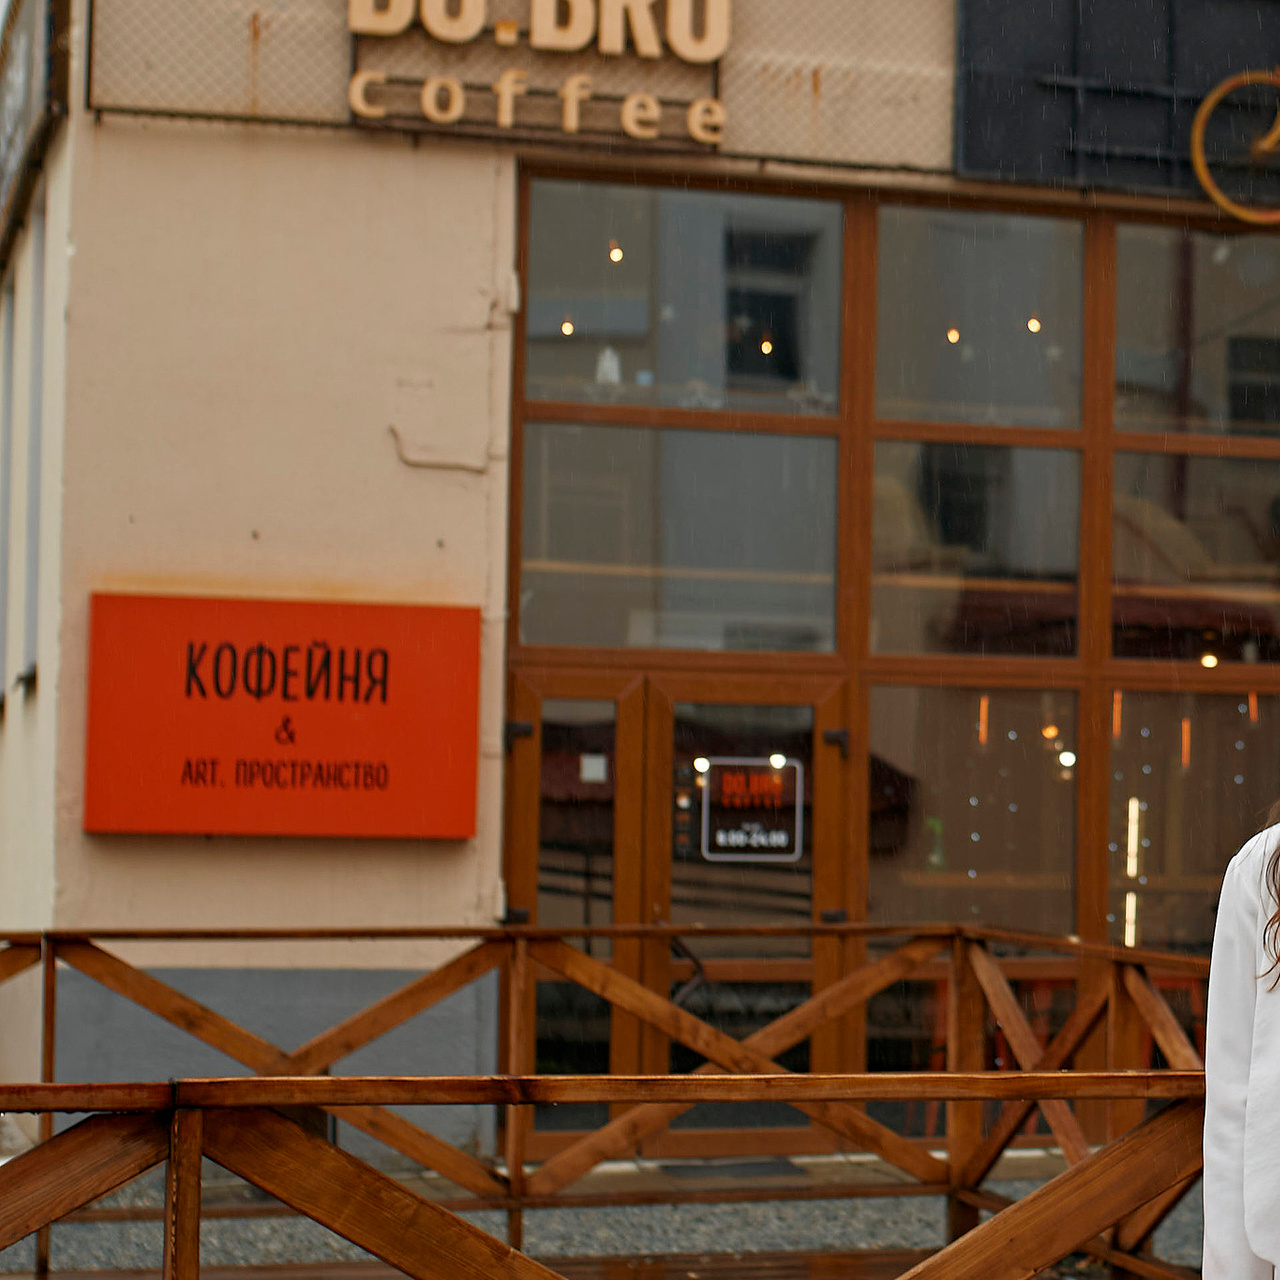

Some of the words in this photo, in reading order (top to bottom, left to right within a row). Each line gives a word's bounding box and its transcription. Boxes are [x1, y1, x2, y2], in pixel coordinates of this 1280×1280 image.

[348, 68, 727, 145] coffee
[184, 640, 389, 705] КОФЕЙНЯ
[274, 715, 296, 746] &
[234, 759, 389, 791] ПРОСТРАНСТВО
